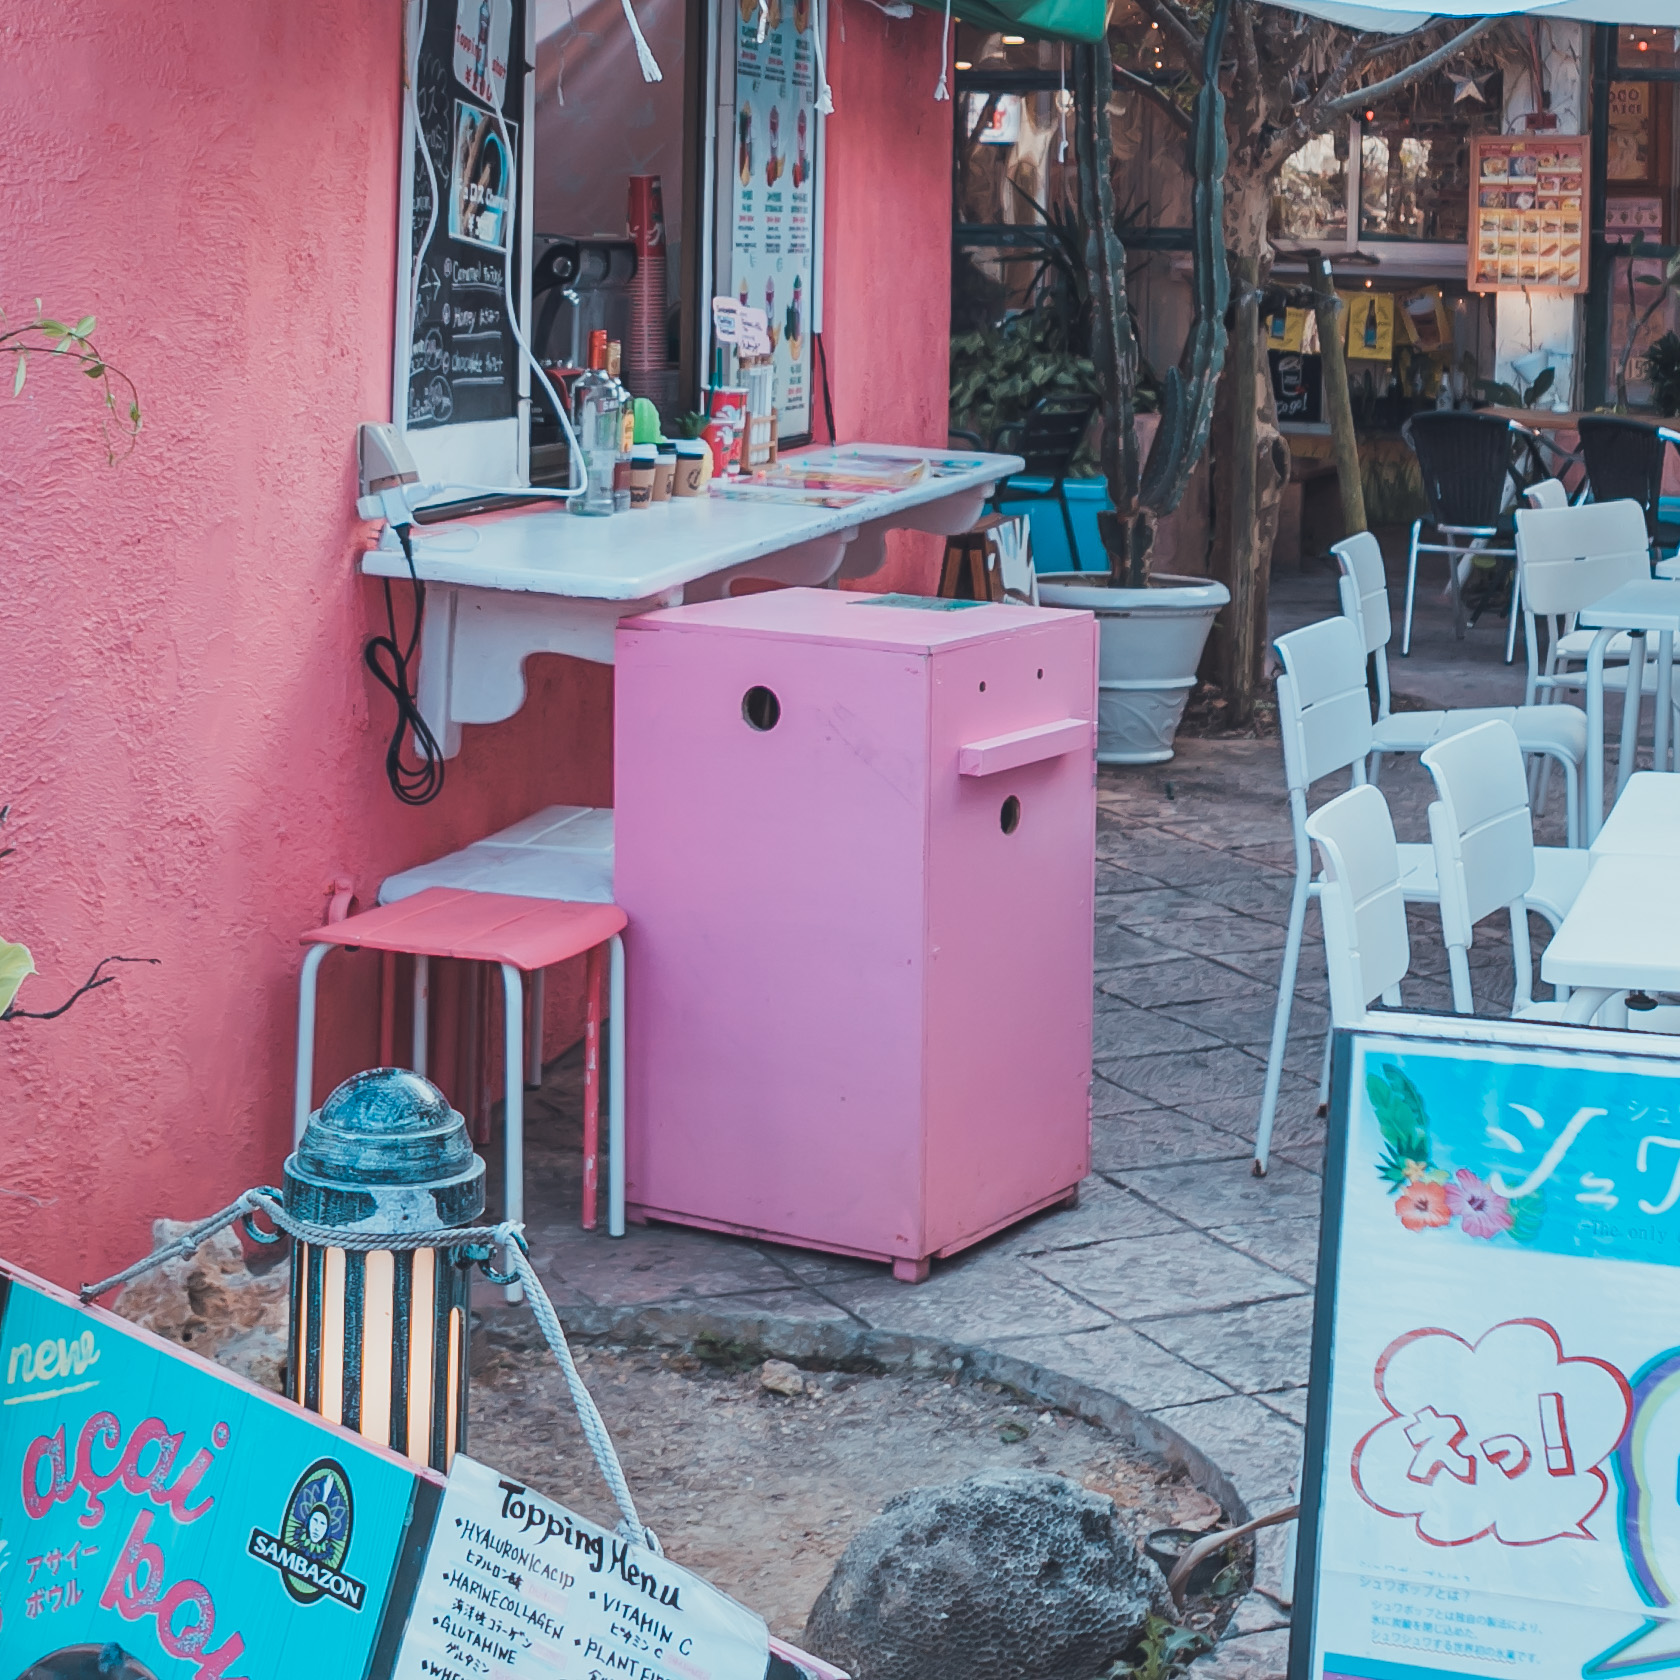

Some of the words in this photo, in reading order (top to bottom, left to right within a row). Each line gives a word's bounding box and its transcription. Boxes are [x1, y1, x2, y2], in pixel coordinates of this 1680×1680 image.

[6, 1330, 101, 1384] new
[22, 1411, 231, 1529] açai
[26, 1540, 100, 1583] アサイー
[498, 1479, 604, 1573] Topping
[607, 1539, 684, 1612] Menu
[253, 1535, 361, 1605] SAMBAZON
[26, 1578, 84, 1619] ボウル
[584, 1637, 640, 1677] PLANT
[679, 1638, 693, 1656] C
